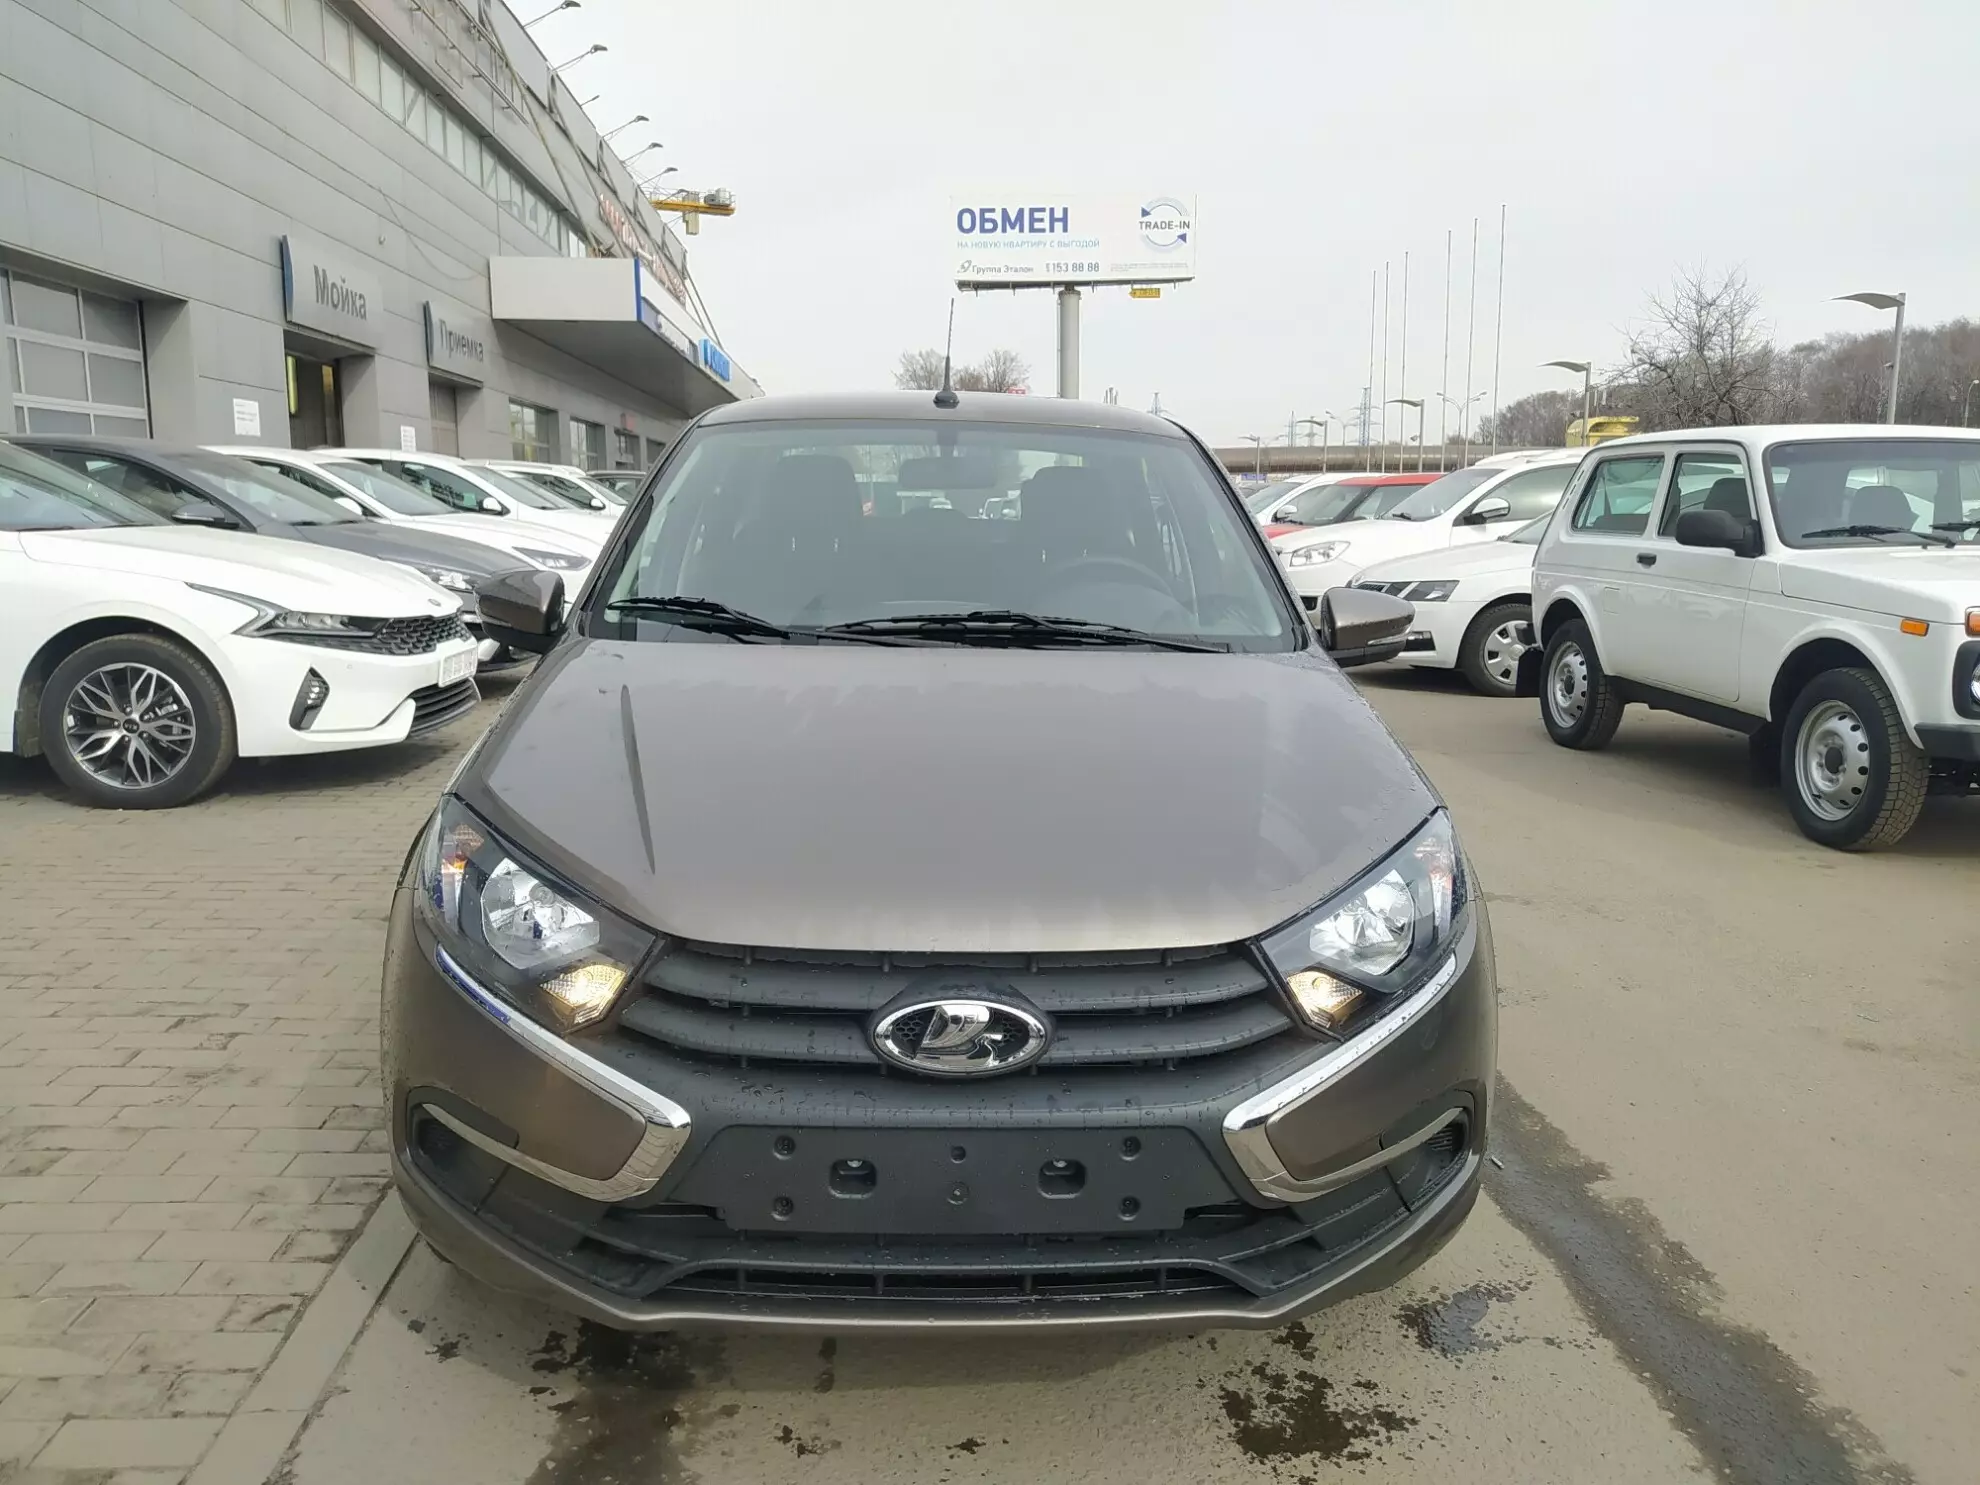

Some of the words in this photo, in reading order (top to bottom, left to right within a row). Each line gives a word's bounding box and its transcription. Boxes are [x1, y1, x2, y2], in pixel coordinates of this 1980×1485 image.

[957, 207, 1069, 234] ОБМЕН
[1139, 220, 1190, 230] TRADE-IN
[957, 240, 969, 249] НА
[971, 240, 1001, 249] НОВУЮ
[1057, 238, 1100, 249] ВЫГОДОЙ
[972, 264, 1002, 275] Группа
[1003, 264, 1034, 274] Эталон
[1052, 262, 1069, 273] 153
[313, 265, 368, 320] Мойка
[438, 317, 484, 362] Приемка
